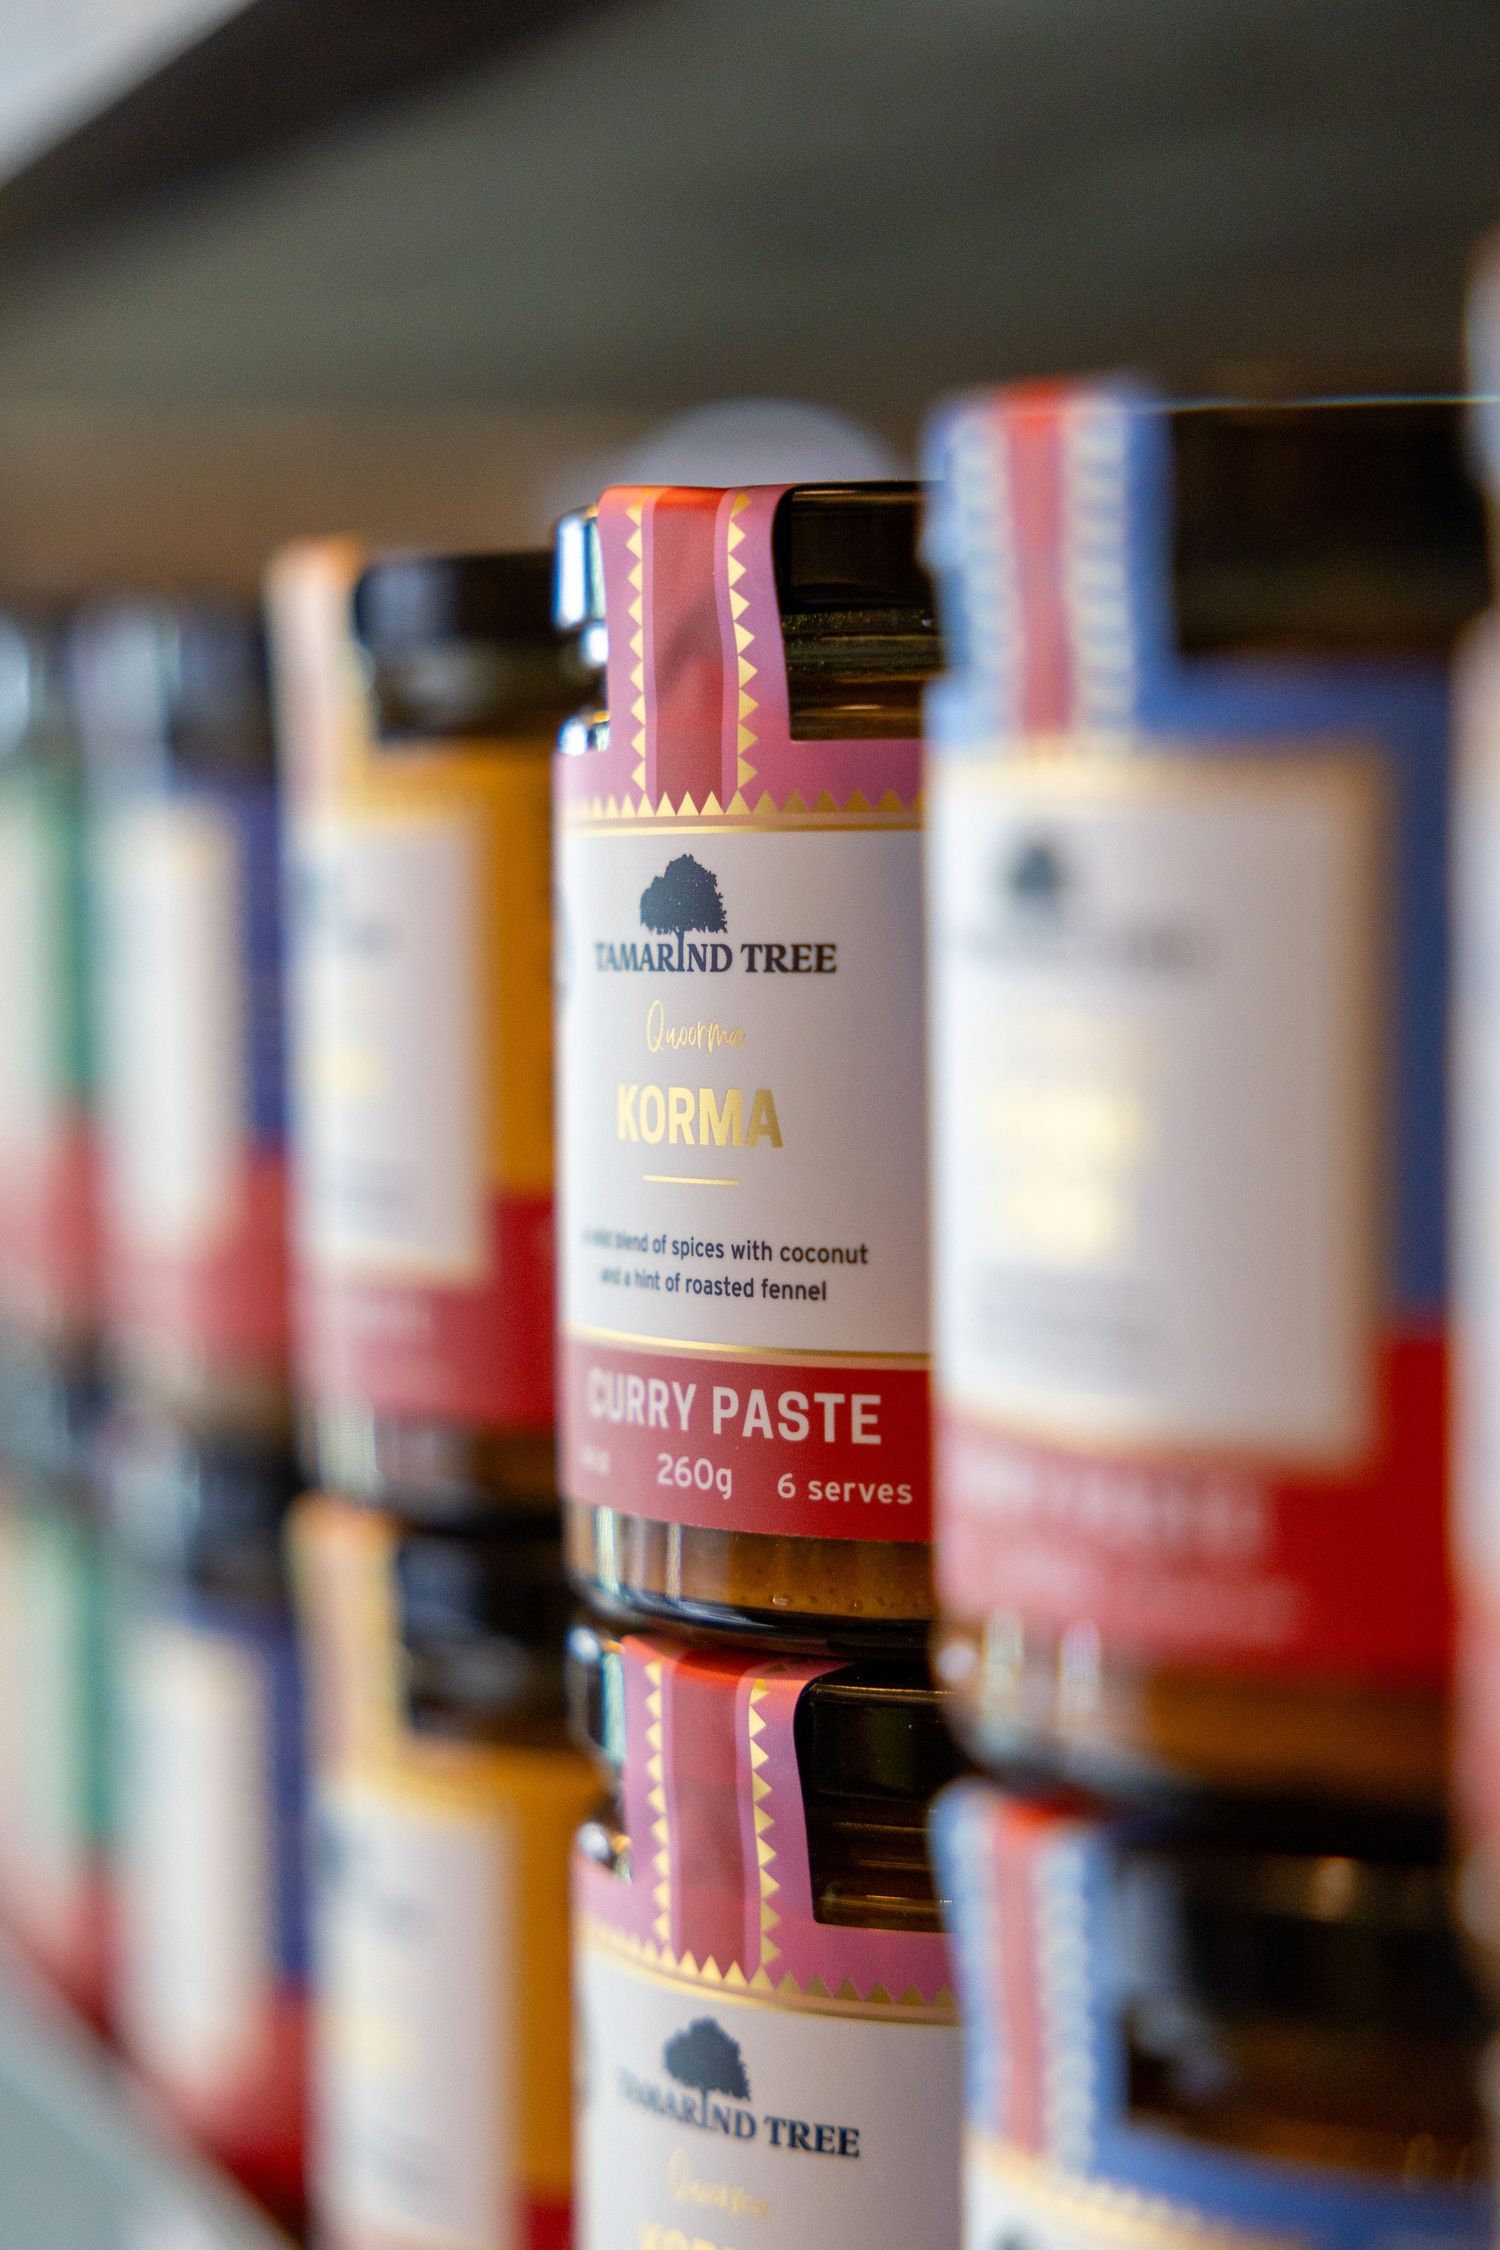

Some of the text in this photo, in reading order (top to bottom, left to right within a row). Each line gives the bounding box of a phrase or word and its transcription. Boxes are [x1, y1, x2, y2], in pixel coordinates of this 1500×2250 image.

[595, 941, 837, 974] TAMARIND TREE
[617, 1084, 784, 1148] KORMA
[653, 1234, 668, 1254] of
[672, 1237, 724, 1260] spices
[731, 1240, 772, 1262] with
[780, 1243, 868, 1265] coconut
[635, 1270, 660, 1290] hint
[665, 1272, 680, 1292] of
[685, 1275, 754, 1298] roasted
[761, 1279, 826, 1301] fennel
[588, 1367, 882, 1446] CURRY PASTE
[656, 1452, 913, 1504] 260g 6 serves
[763, 2115, 861, 2159] TREE
